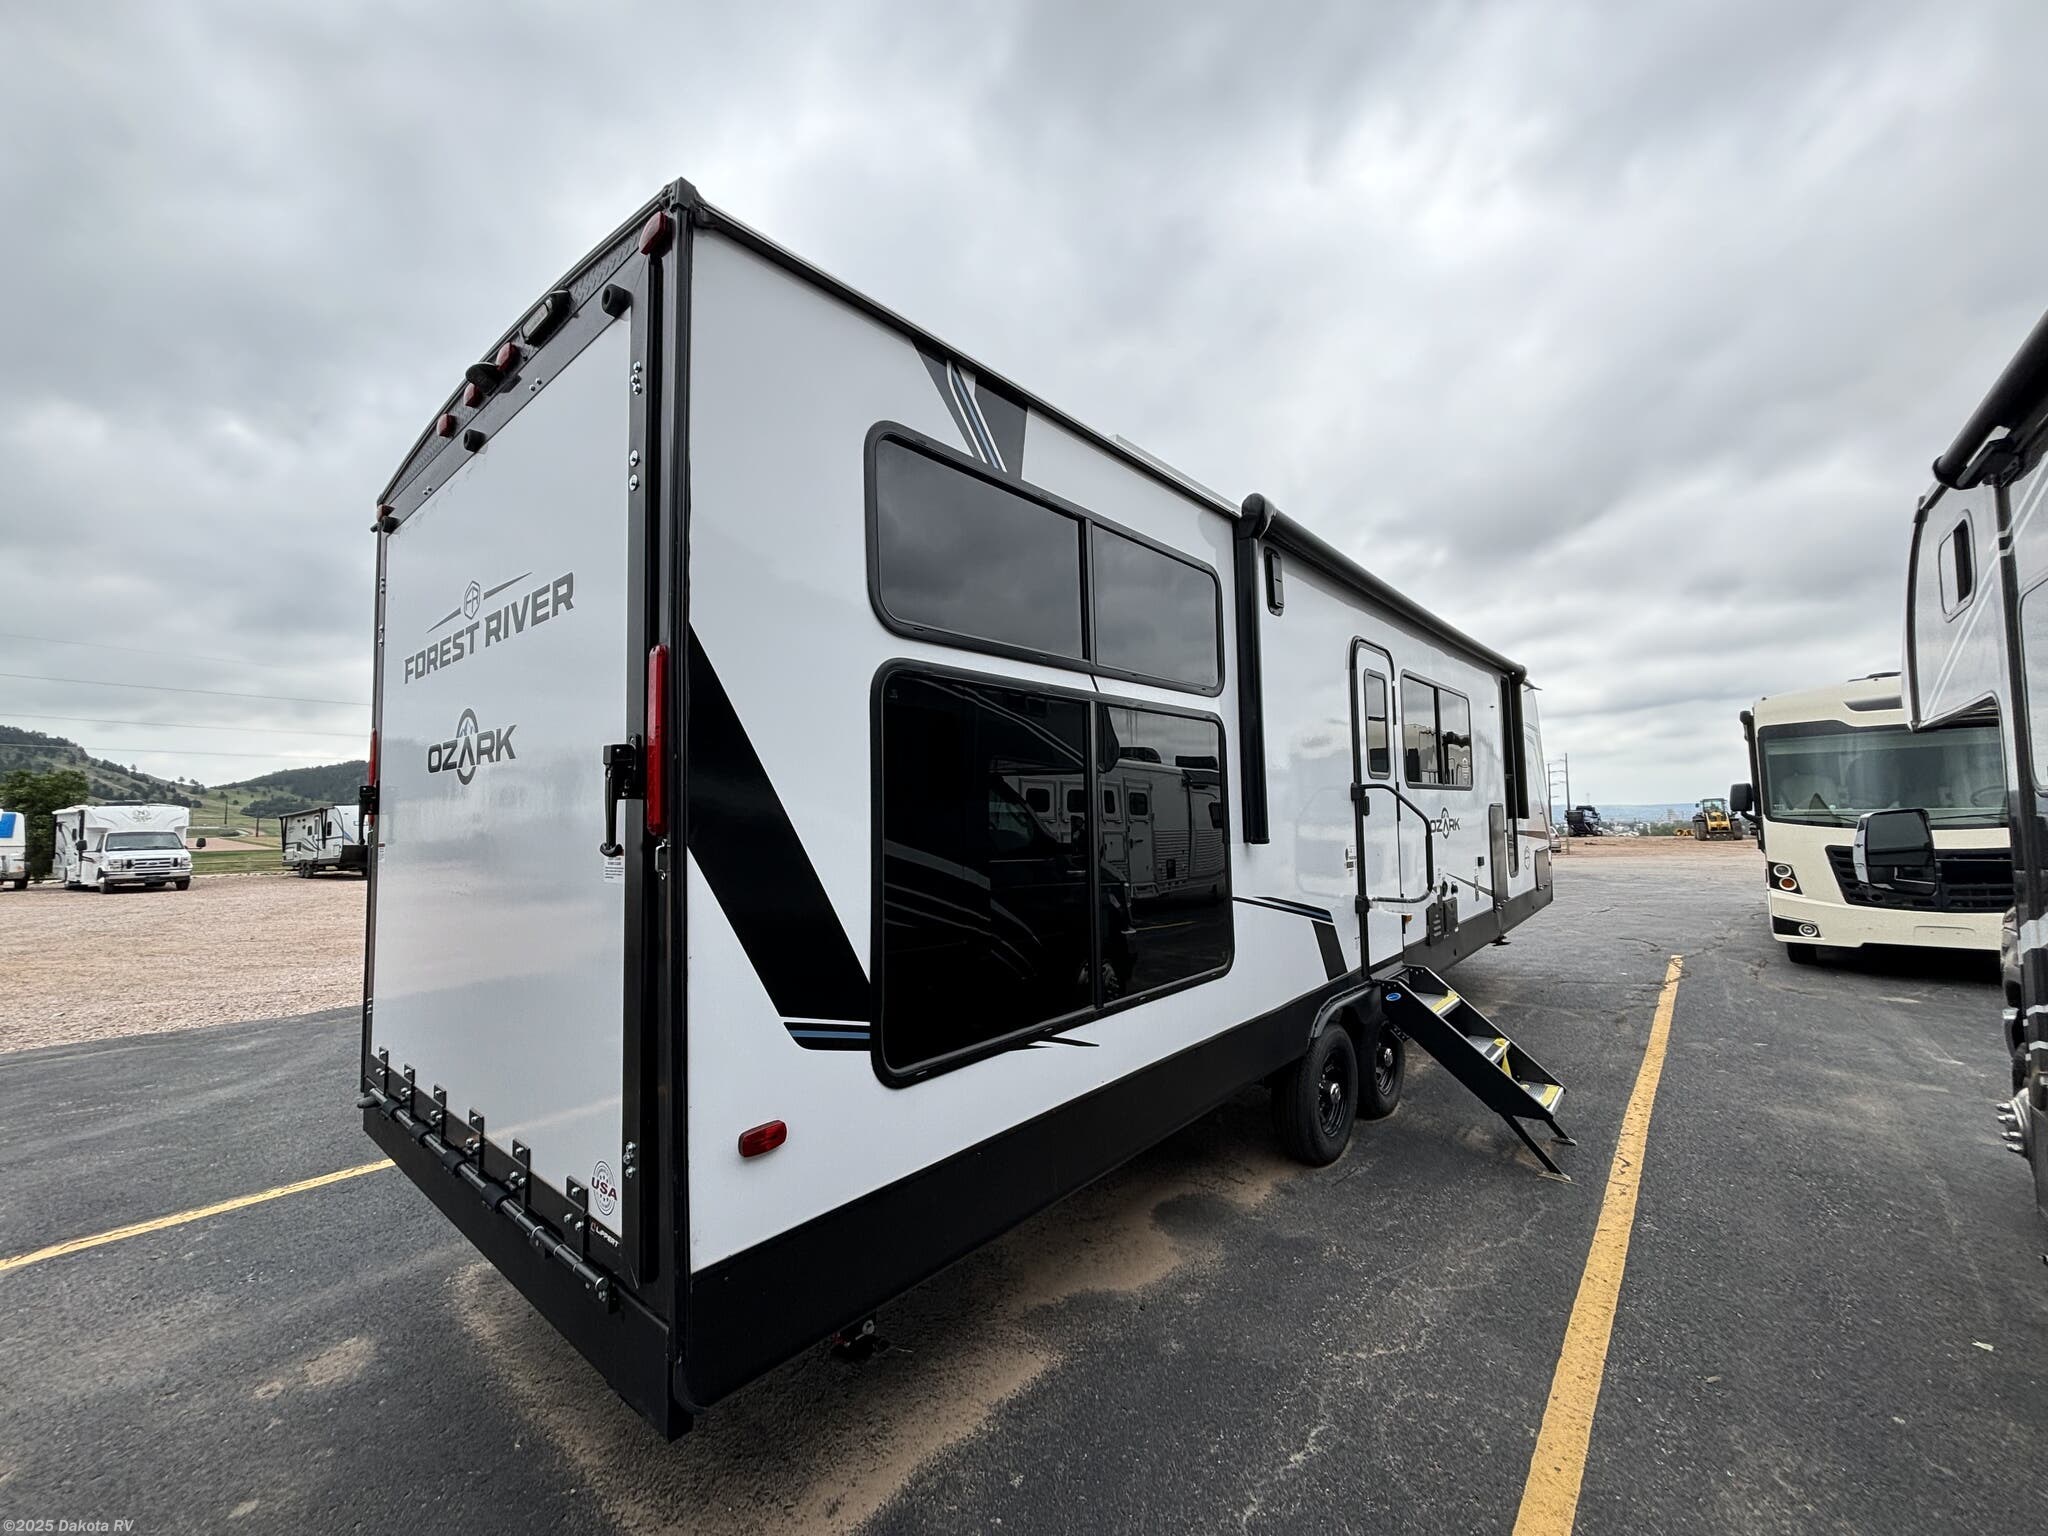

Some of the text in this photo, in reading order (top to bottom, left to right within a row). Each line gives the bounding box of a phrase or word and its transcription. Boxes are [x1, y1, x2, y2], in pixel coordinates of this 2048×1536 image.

[404, 571, 574, 684] FOREST RIVER
[427, 724, 517, 773] OZARK
[591, 1177, 617, 1200] USA
